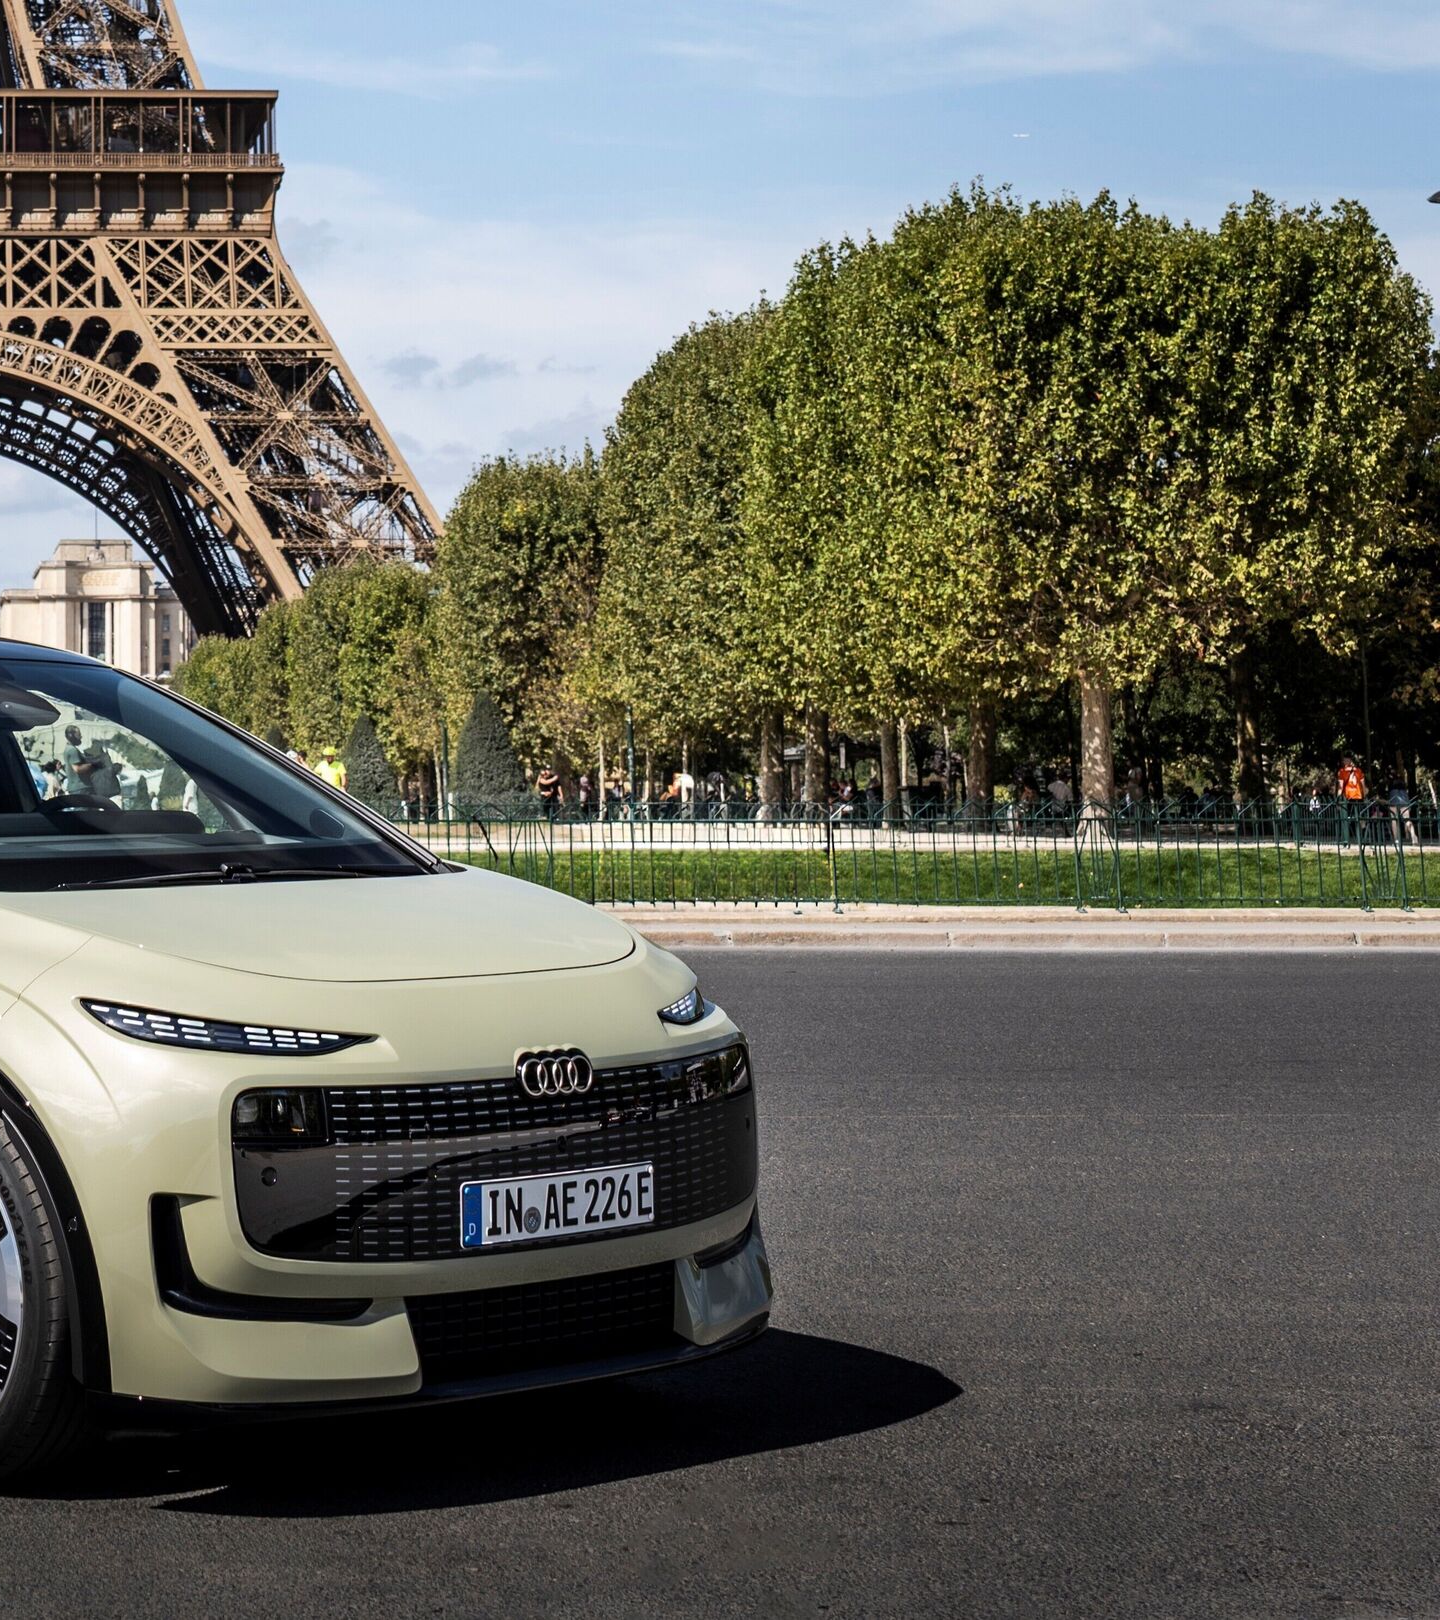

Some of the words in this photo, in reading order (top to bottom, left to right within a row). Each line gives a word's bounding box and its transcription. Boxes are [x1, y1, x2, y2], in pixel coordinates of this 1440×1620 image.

[486, 1187, 523, 1236] IN
[544, 1181, 578, 1229] AE
[469, 1223, 476, 1236] D
